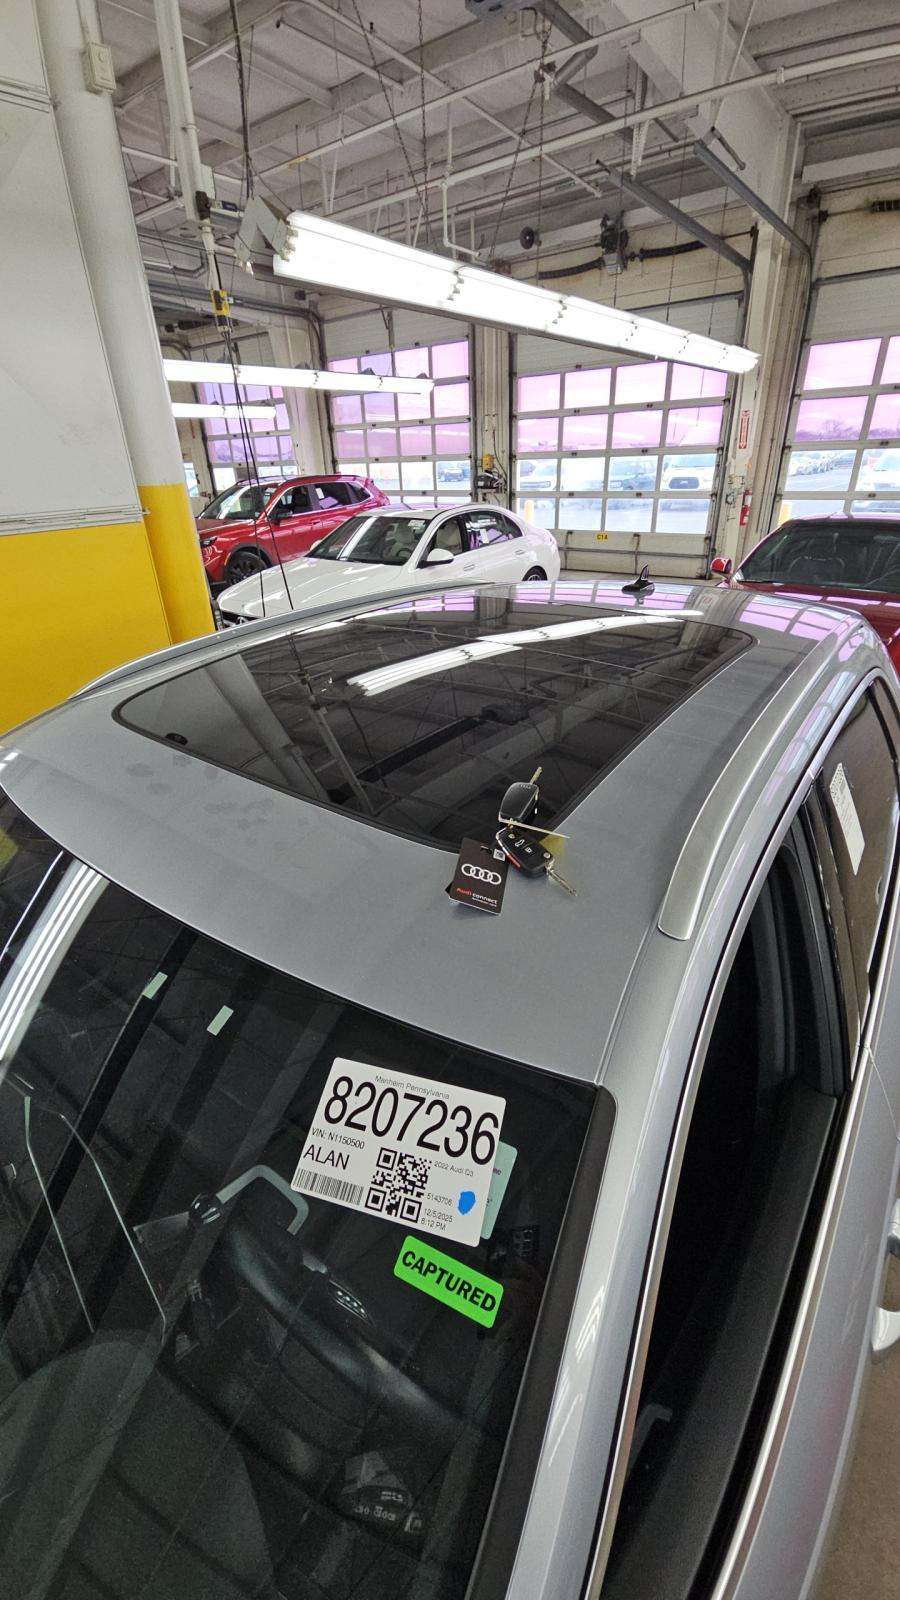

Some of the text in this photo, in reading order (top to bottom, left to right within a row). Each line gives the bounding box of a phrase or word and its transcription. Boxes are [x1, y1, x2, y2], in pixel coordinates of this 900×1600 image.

[456, 887, 472, 896] Audi
[472, 893, 498, 904] connect
[374, 1075, 450, 1100] Manheim Pennsylvania
[324, 1076, 499, 1165] 8207236
[312, 1127, 365, 1149] VIN: N1150500
[303, 1144, 351, 1170] ALAN
[434, 1161, 474, 1177] 2022 Audi Q3
[435, 1222, 447, 1231] PM
[402, 1250, 496, 1312] CAPTURED
